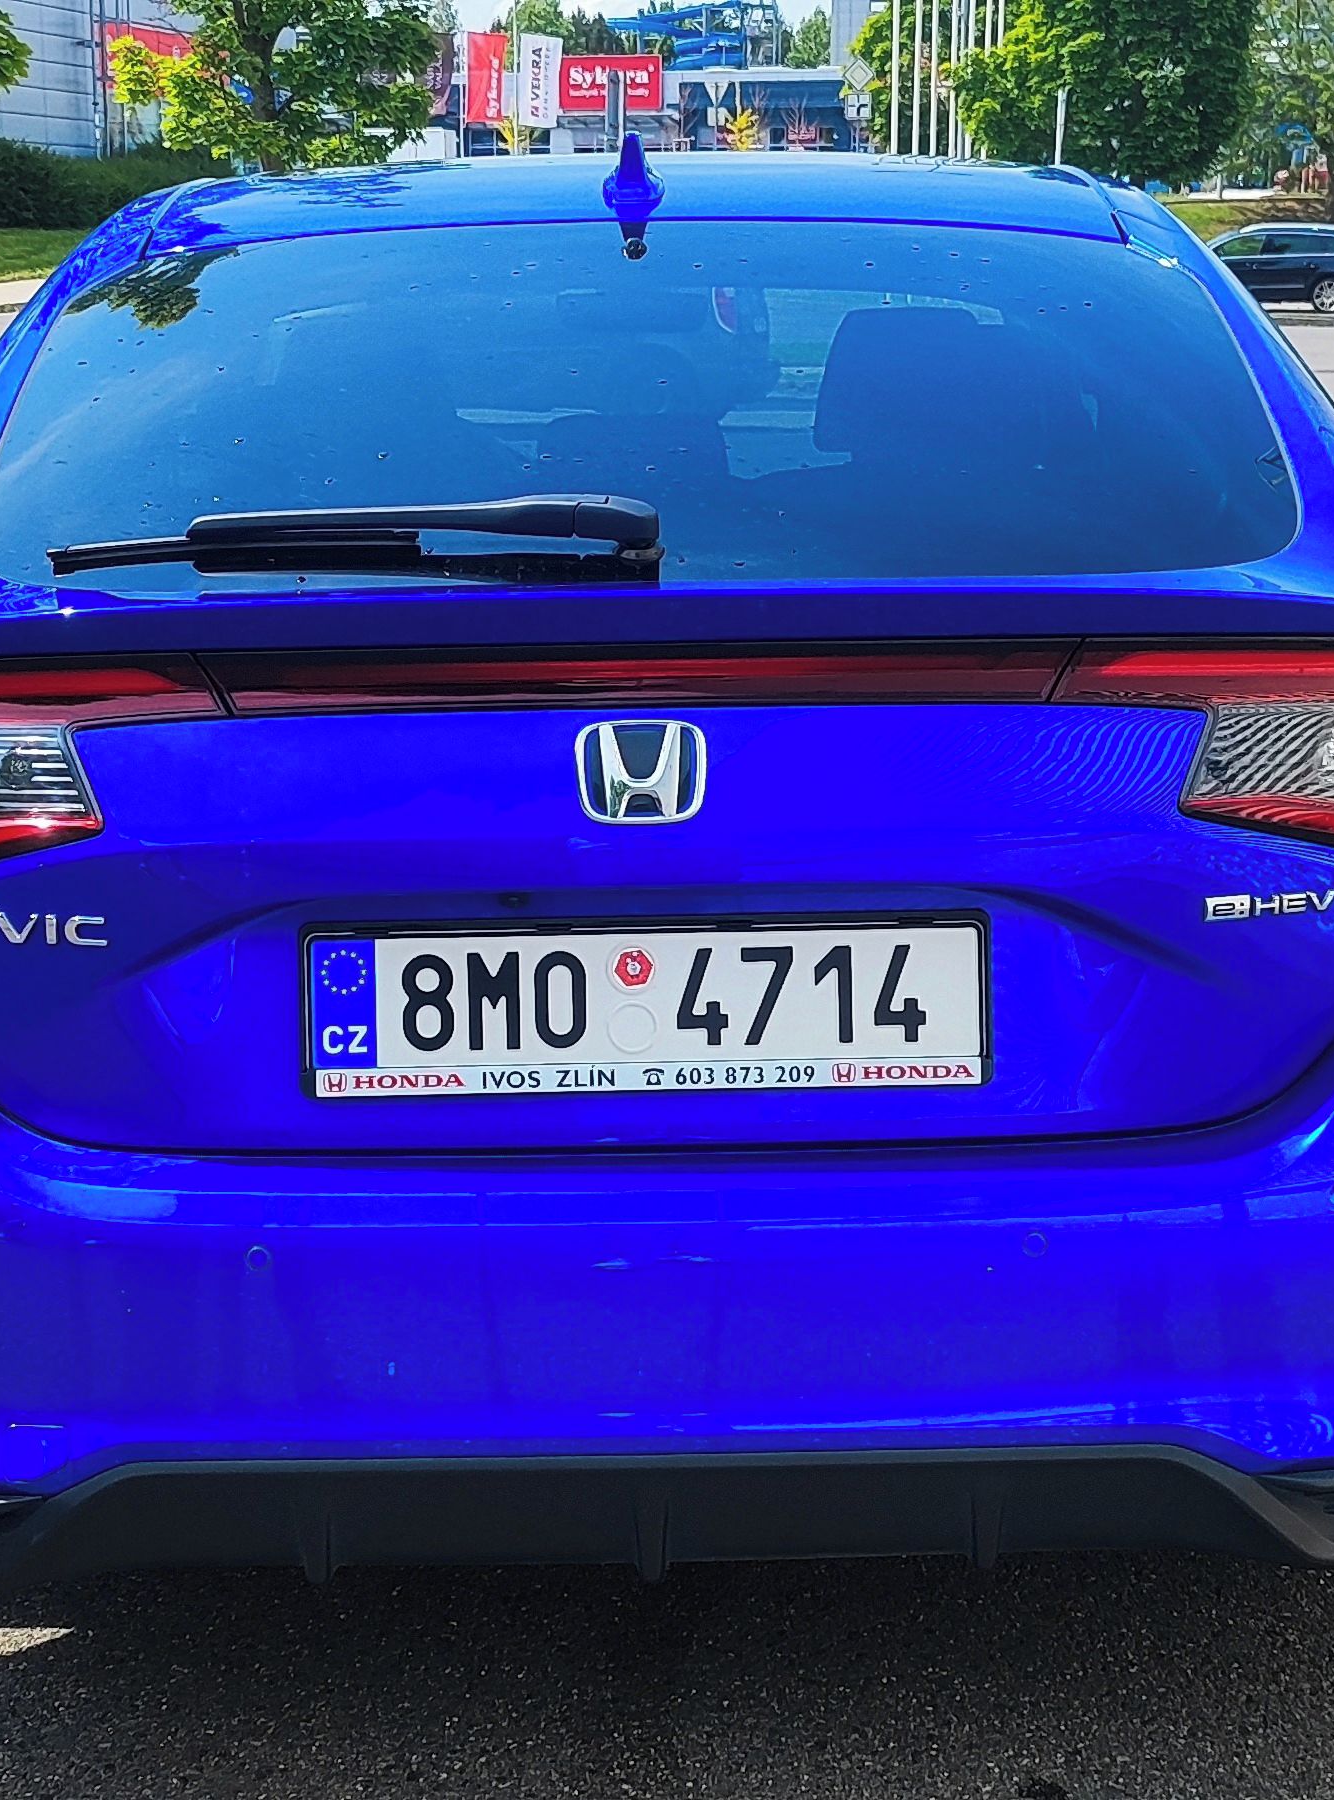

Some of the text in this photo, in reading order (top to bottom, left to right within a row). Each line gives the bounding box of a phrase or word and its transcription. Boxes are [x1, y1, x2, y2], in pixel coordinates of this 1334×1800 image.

[531, 47, 543, 102] VEKRA
[569, 65, 650, 89] Sykra
[676, 944, 927, 1047] 4714
[322, 1025, 369, 1054] CZ
[353, 1074, 466, 1090] HONDA
[482, 1070, 541, 1090] IVOS
[556, 1065, 616, 1088] ZLÍN
[675, 1067, 715, 1085] 603
[725, 1066, 765, 1084] 873
[775, 1065, 815, 1083] 209
[861, 1064, 975, 1080] HONDA
